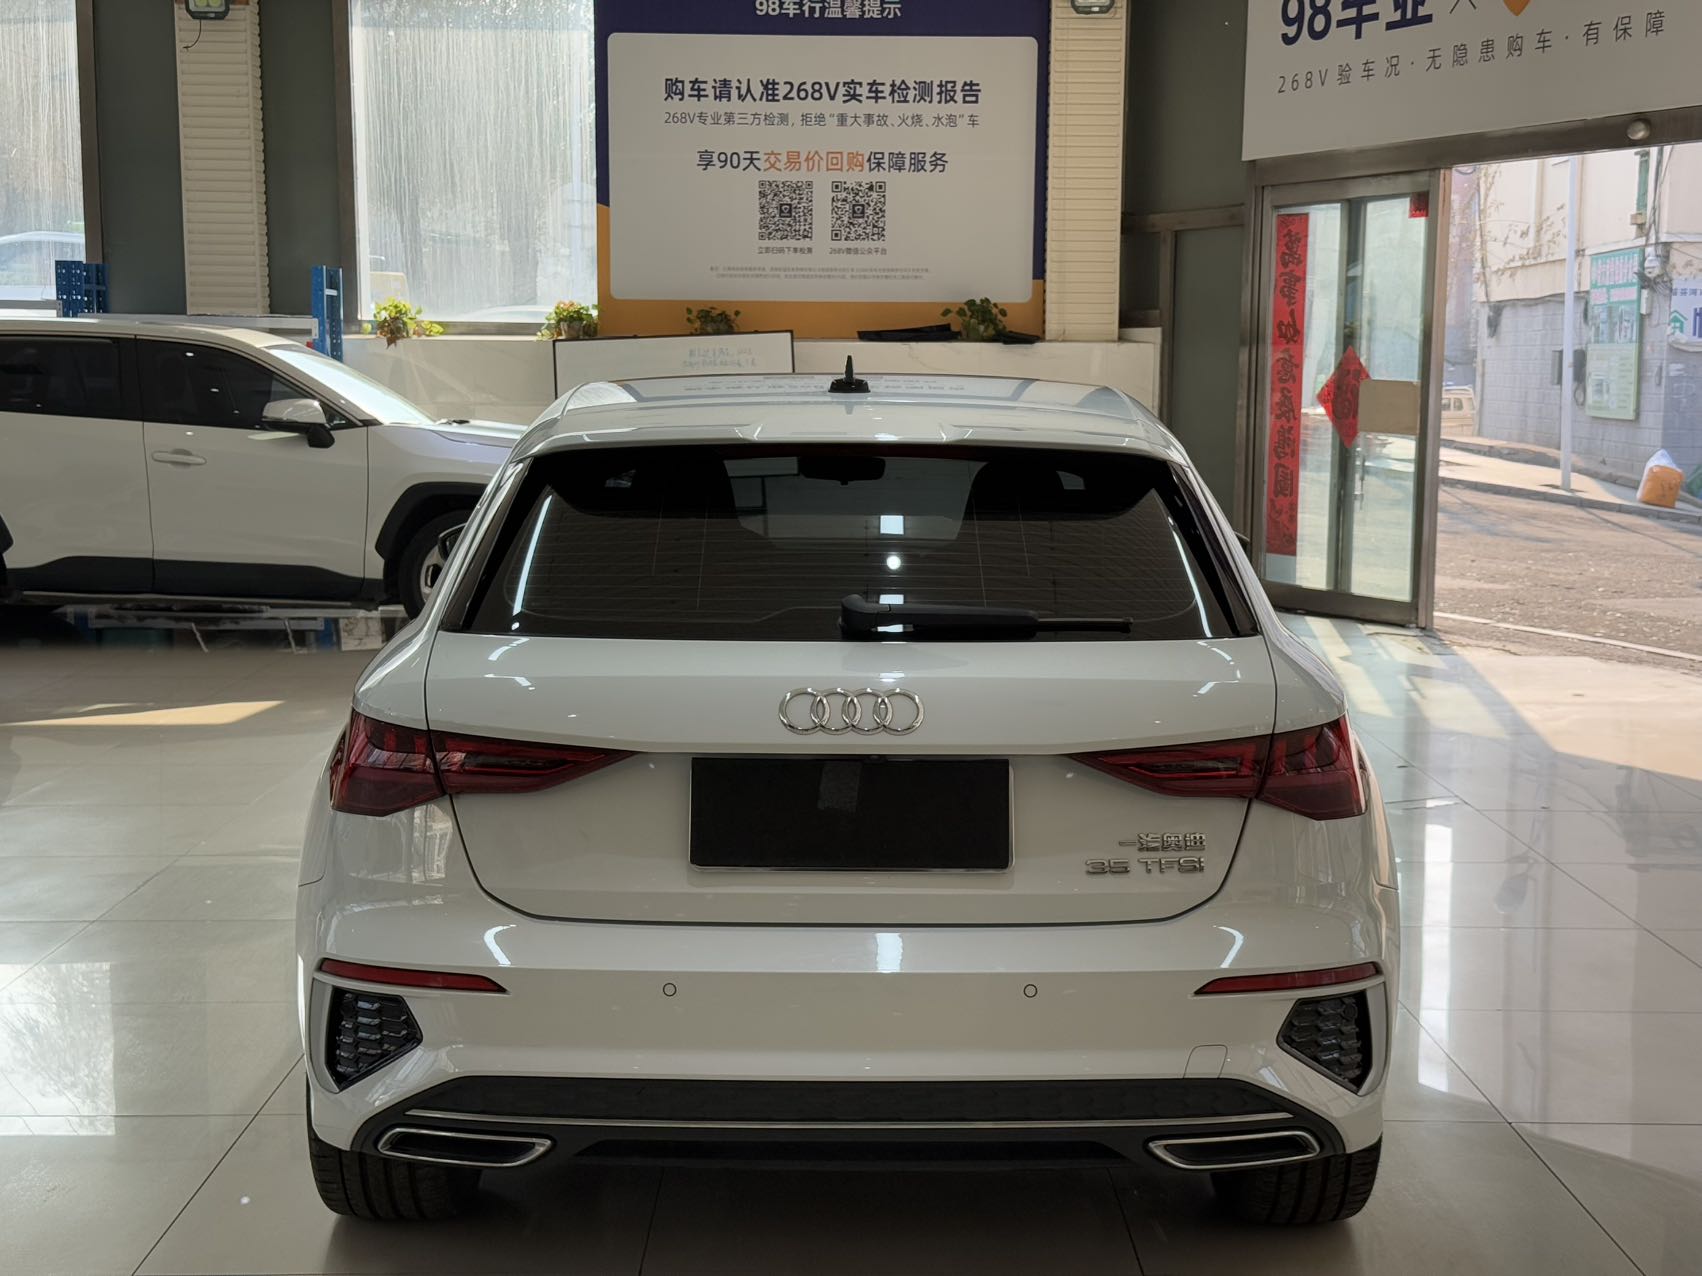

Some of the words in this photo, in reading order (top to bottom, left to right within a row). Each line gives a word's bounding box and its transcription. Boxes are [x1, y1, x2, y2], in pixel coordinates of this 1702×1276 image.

[755, 0, 902, 18] 98车行温馨提示
[664, 77, 982, 105] 购车请认准268V实车检测报告
[696, 150, 949, 174] 享90天交易价回购保障服务
[1118, 832, 1206, 851] 一汽奥迪
[1085, 858, 1130, 874] 35
